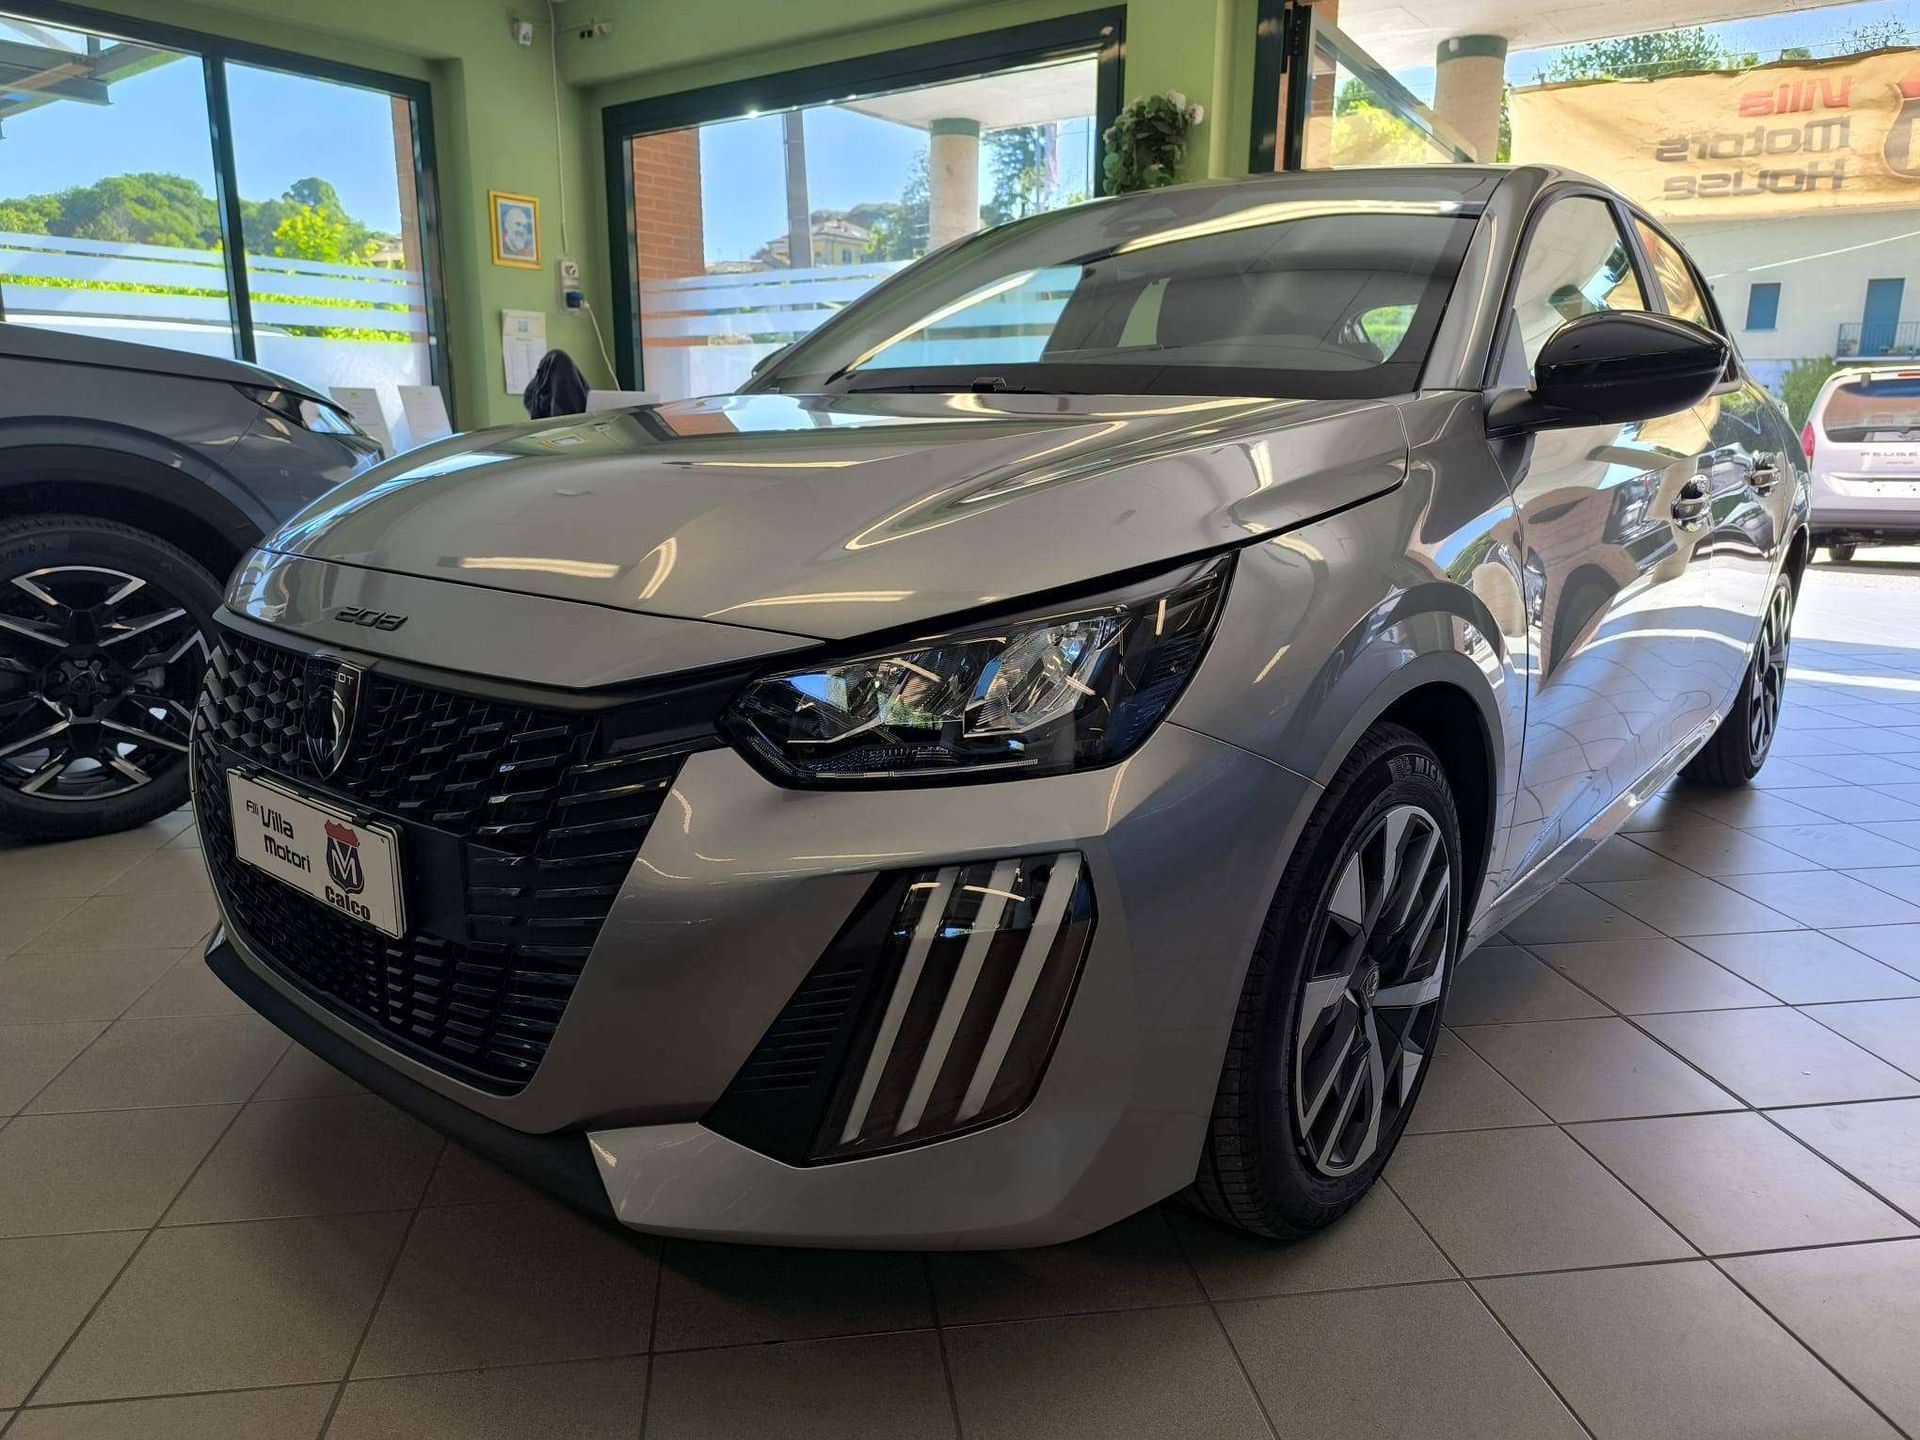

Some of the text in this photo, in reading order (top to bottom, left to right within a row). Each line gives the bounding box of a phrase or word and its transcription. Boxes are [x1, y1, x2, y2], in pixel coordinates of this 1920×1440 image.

[335, 606, 408, 631] 208
[260, 804, 294, 840] Villa
[264, 834, 311, 873] Motori
[325, 885, 371, 921] Calco
